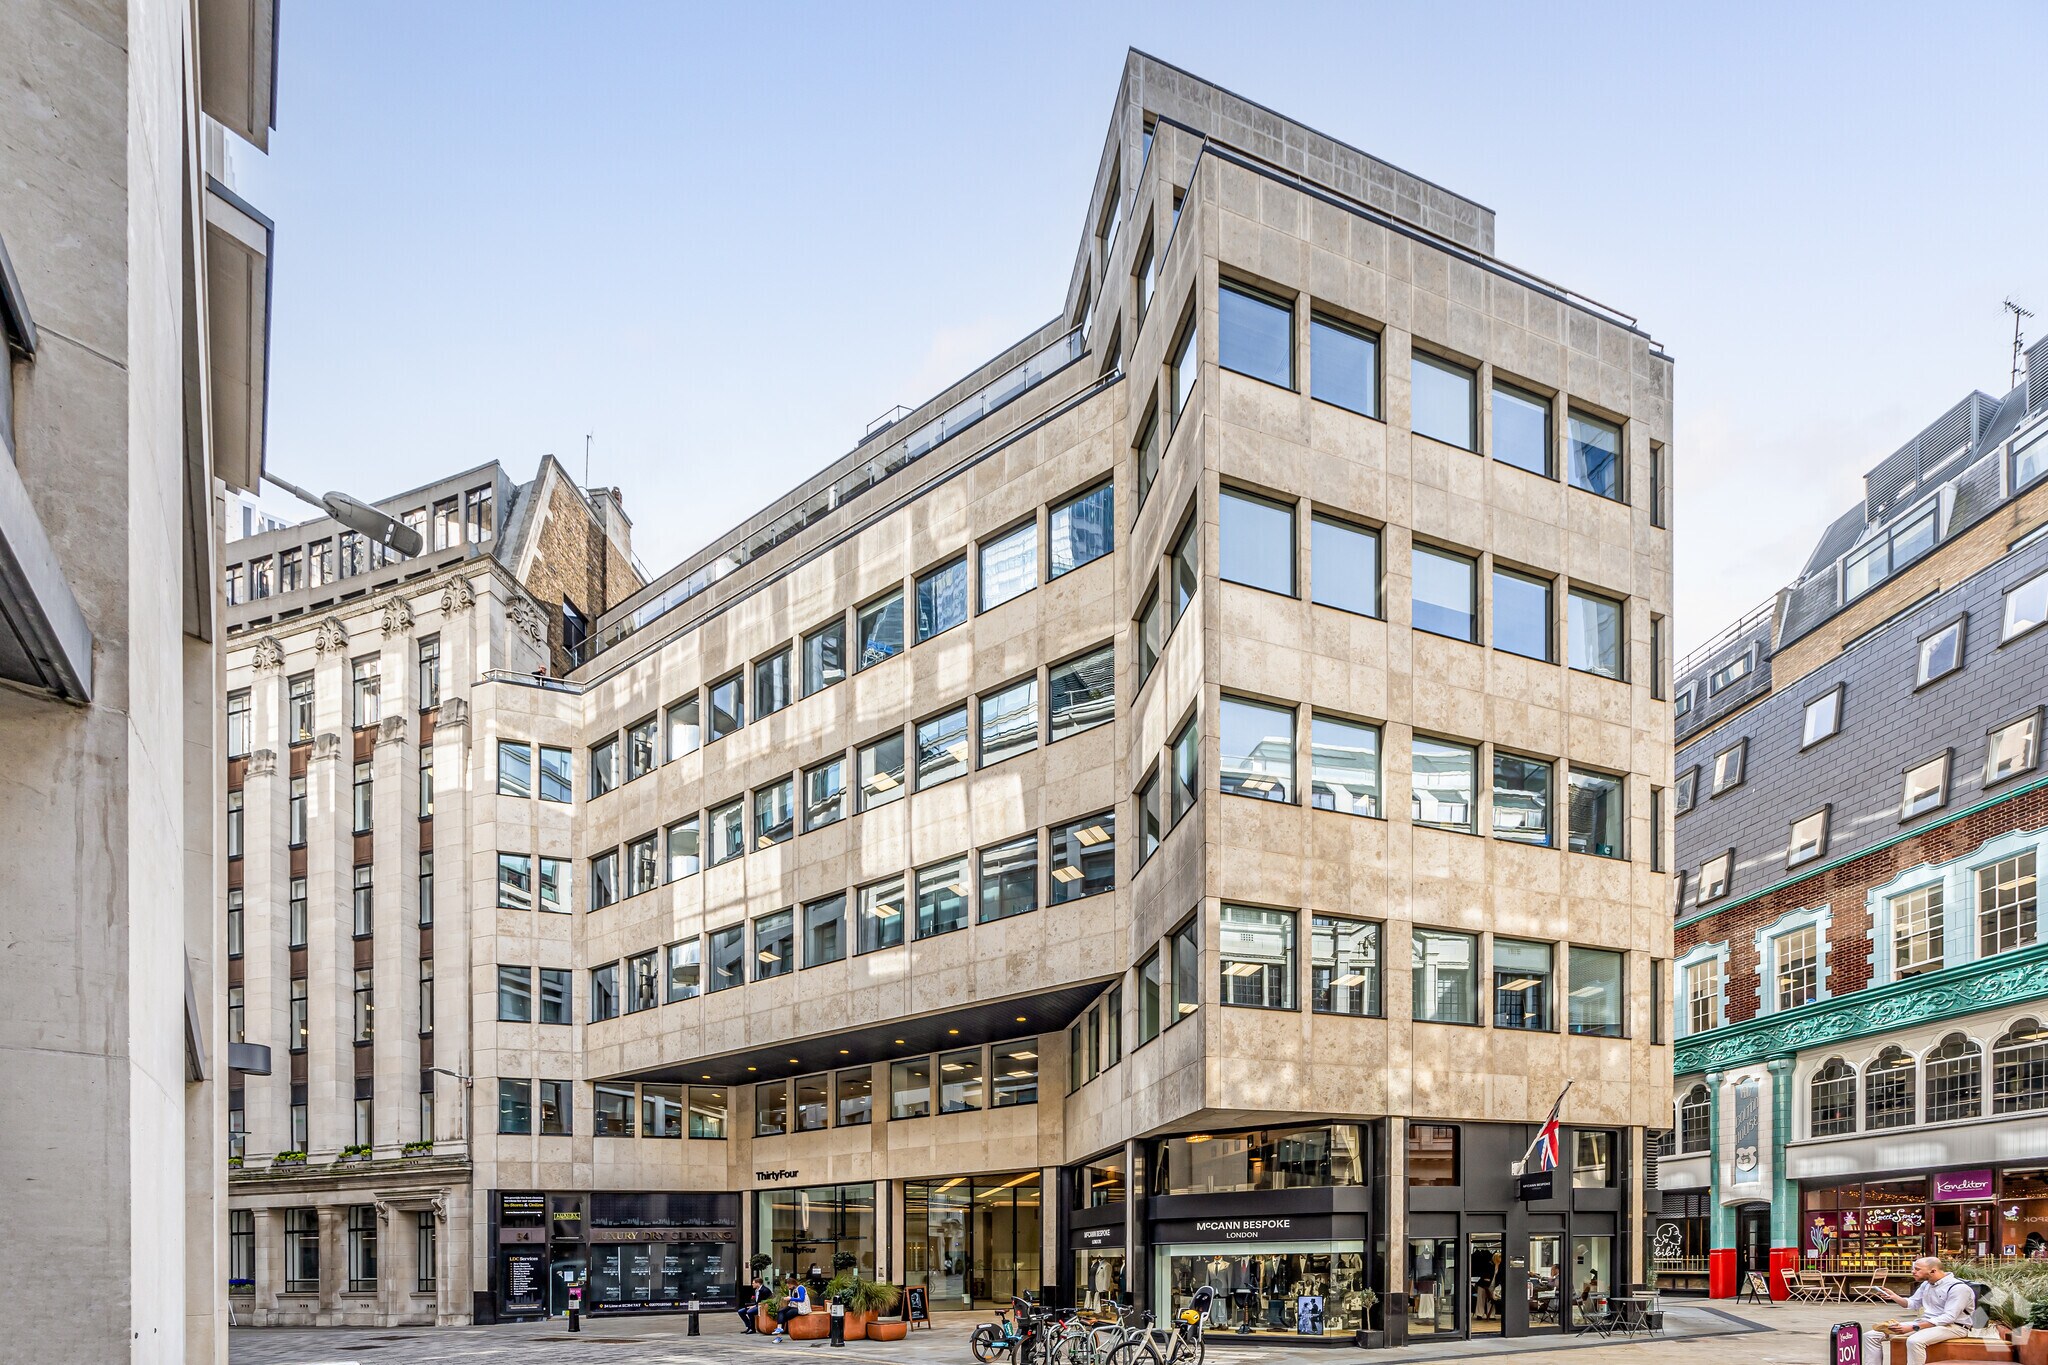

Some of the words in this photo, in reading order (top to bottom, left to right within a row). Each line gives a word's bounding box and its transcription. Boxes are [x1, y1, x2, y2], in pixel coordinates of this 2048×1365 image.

[756, 1170, 799, 1181] ThirtyFour
[1937, 1180, 1989, 1193] Konditor
[1892, 1208, 1922, 1226] Spring
[1196, 1221, 1240, 1231] McCANN
[1243, 1219, 1290, 1229] BESPOKE
[516, 1232, 529, 1241] 34
[597, 1231, 638, 1240] LUXURY
[643, 1231, 665, 1241] DRY
[671, 1231, 733, 1240] CLEANING
[782, 1246, 816, 1254] ThirtyFour
[1654, 1246, 1682, 1256] bibi's
[1839, 1345, 1857, 1362] JOY
